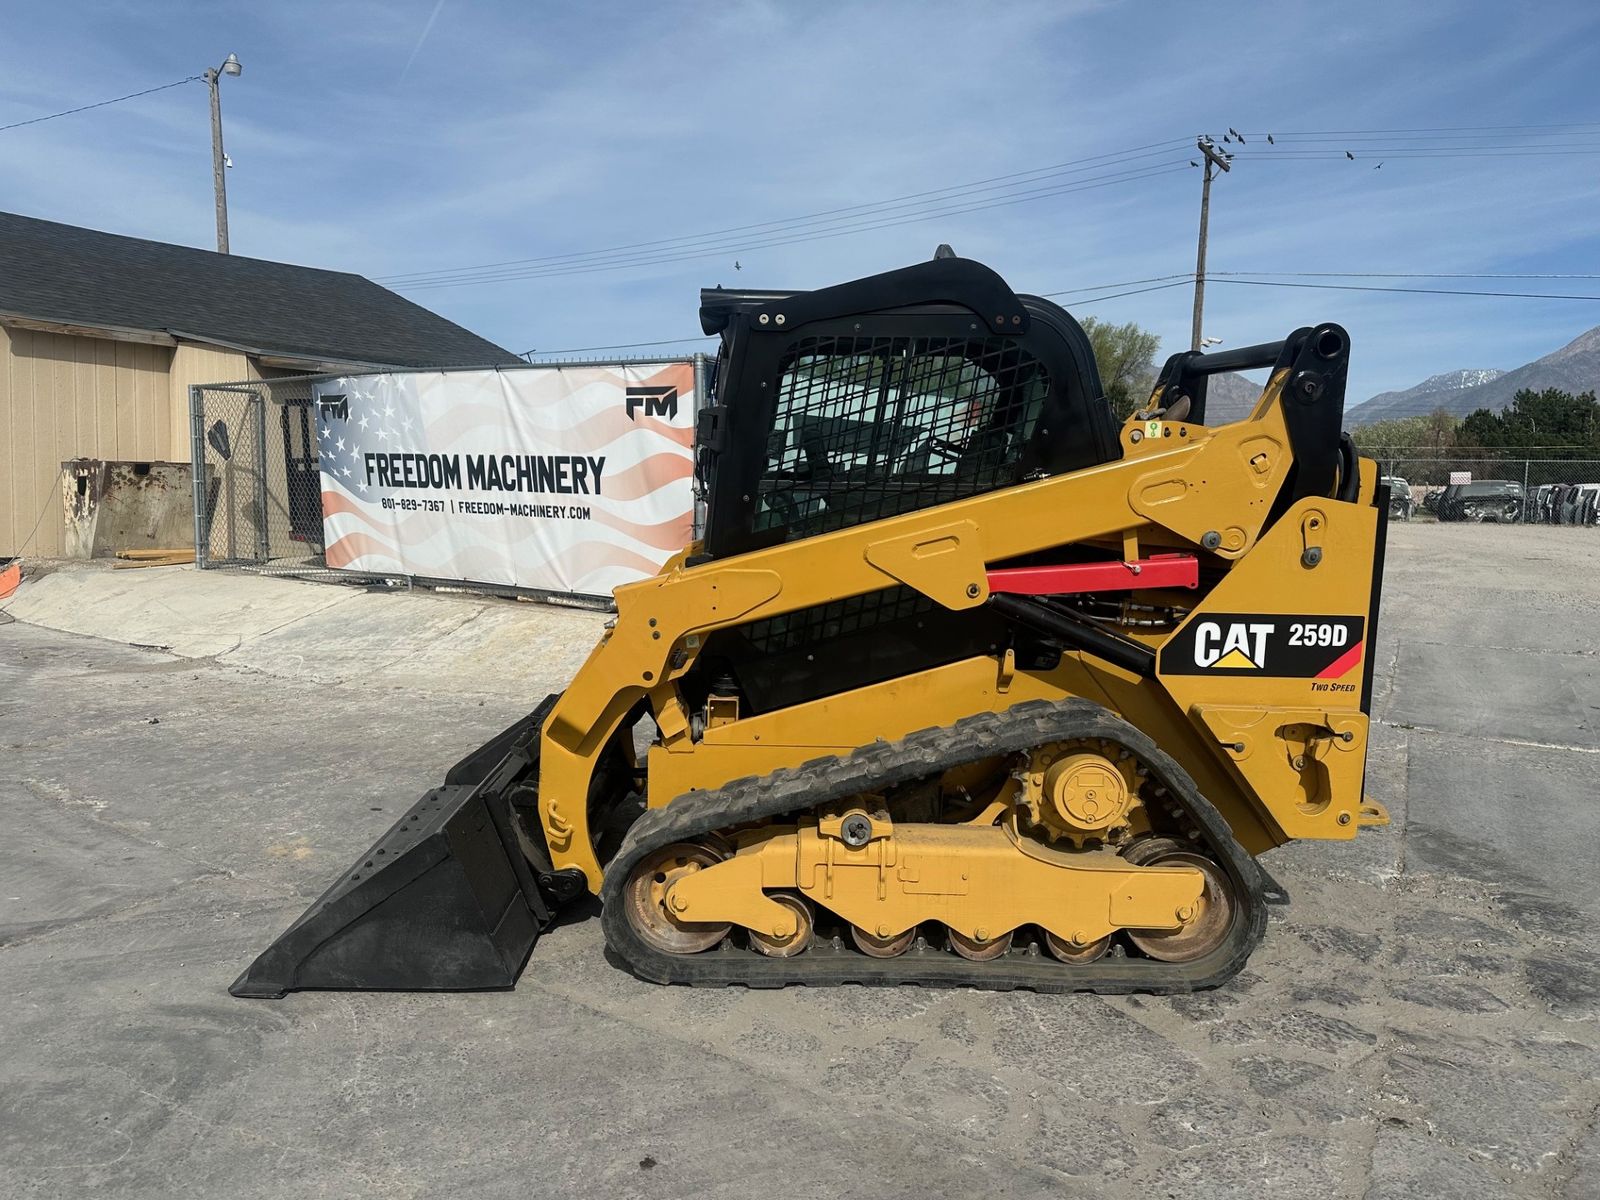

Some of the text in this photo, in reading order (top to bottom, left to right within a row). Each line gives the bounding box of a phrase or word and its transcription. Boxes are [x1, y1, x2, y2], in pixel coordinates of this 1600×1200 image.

[320, 394, 349, 424] FM
[626, 386, 678, 422] FM
[364, 452, 607, 496] FREEDOM MACHINERY
[381, 498, 445, 512] 801-829-7367
[458, 501, 591, 520] FREEDOM-MACHINERY.COM
[1194, 621, 1348, 669] CAT 259D
